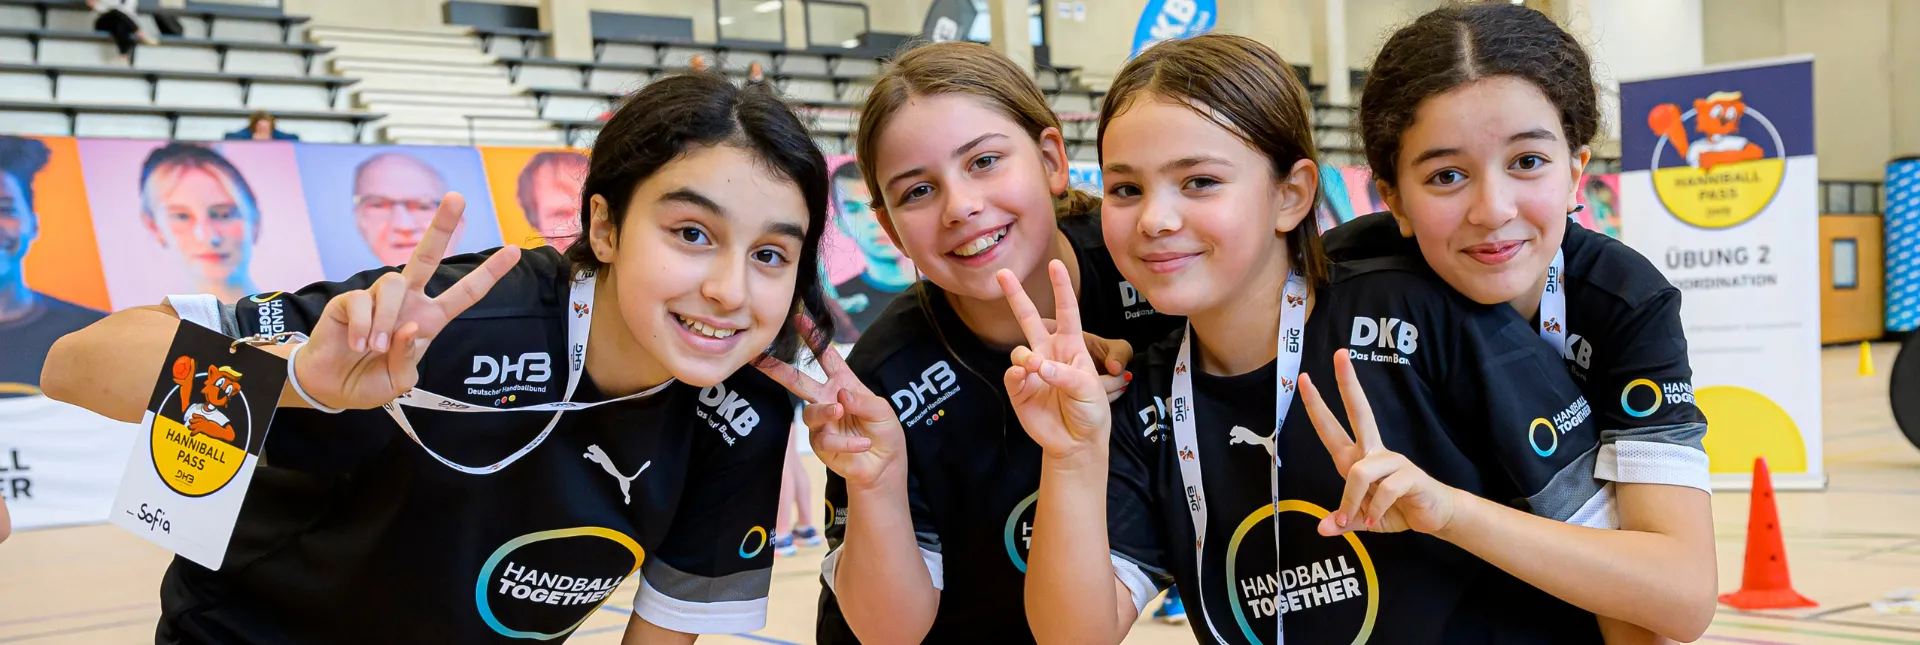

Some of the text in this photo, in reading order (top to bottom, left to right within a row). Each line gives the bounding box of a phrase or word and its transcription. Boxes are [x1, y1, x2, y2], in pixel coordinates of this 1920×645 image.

[1665, 244, 1771, 270] ÜBUNG 2
[1350, 316, 1419, 355] DKB
[1564, 333, 1593, 370] KB
[464, 352, 552, 385] DHB
[1349, 349, 1369, 361] Das
[1371, 351, 1393, 363] kann
[467, 384, 547, 396] Deutscher Handballbund
[891, 360, 957, 422] DHB
[698, 381, 761, 437] DKB
[165, 428, 226, 464] HANNIBALL
[176, 449, 206, 471] PASS
[137, 503, 171, 534] Sofia
[503, 561, 623, 592] HANDBALL
[1240, 555, 1356, 599] HANDBALL
[1247, 577, 1362, 619] TOGETHER
